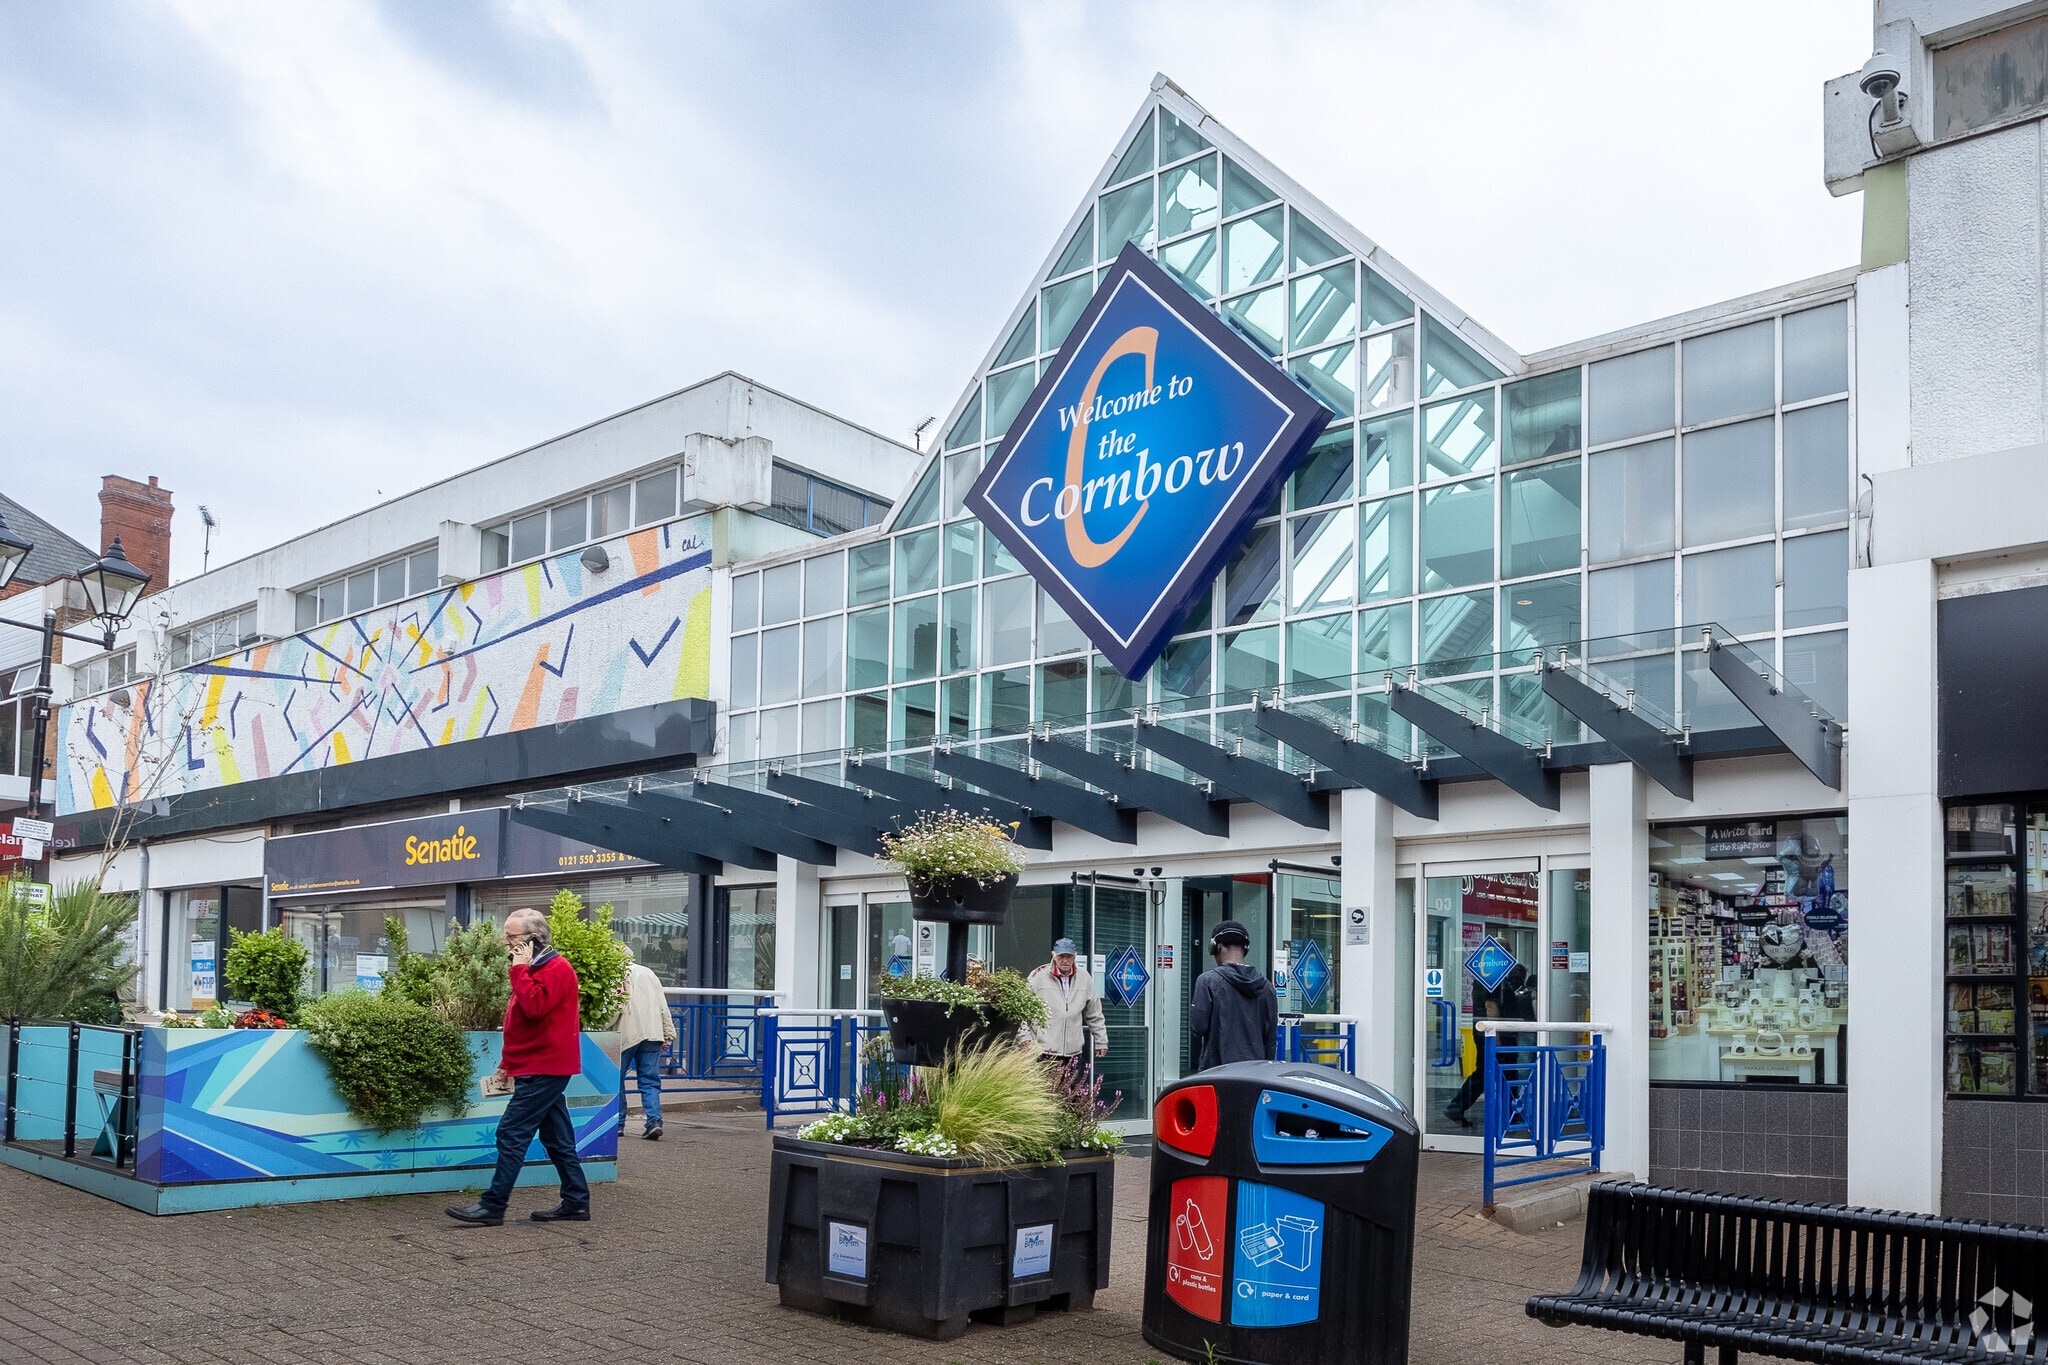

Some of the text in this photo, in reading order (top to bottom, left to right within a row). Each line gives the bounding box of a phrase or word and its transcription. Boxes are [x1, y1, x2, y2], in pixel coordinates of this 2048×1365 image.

[1058, 374, 1193, 432] Welcome to
[1098, 428, 1136, 460] the
[1020, 441, 1244, 527] Cornbow
[1711, 825, 1773, 840] A Write Card
[1710, 841, 1771, 853] at the Right price
[558, 856, 577, 866] 0121
[579, 854, 594, 864] 550
[596, 852, 616, 863] 3355
[618, 852, 625, 861] &
[1472, 957, 1509, 968] Cornbow
[1116, 971, 1144, 981] Cornbow
[1182, 1279, 1216, 1293] plastic bottles
[1261, 1290, 1283, 1299] paper
